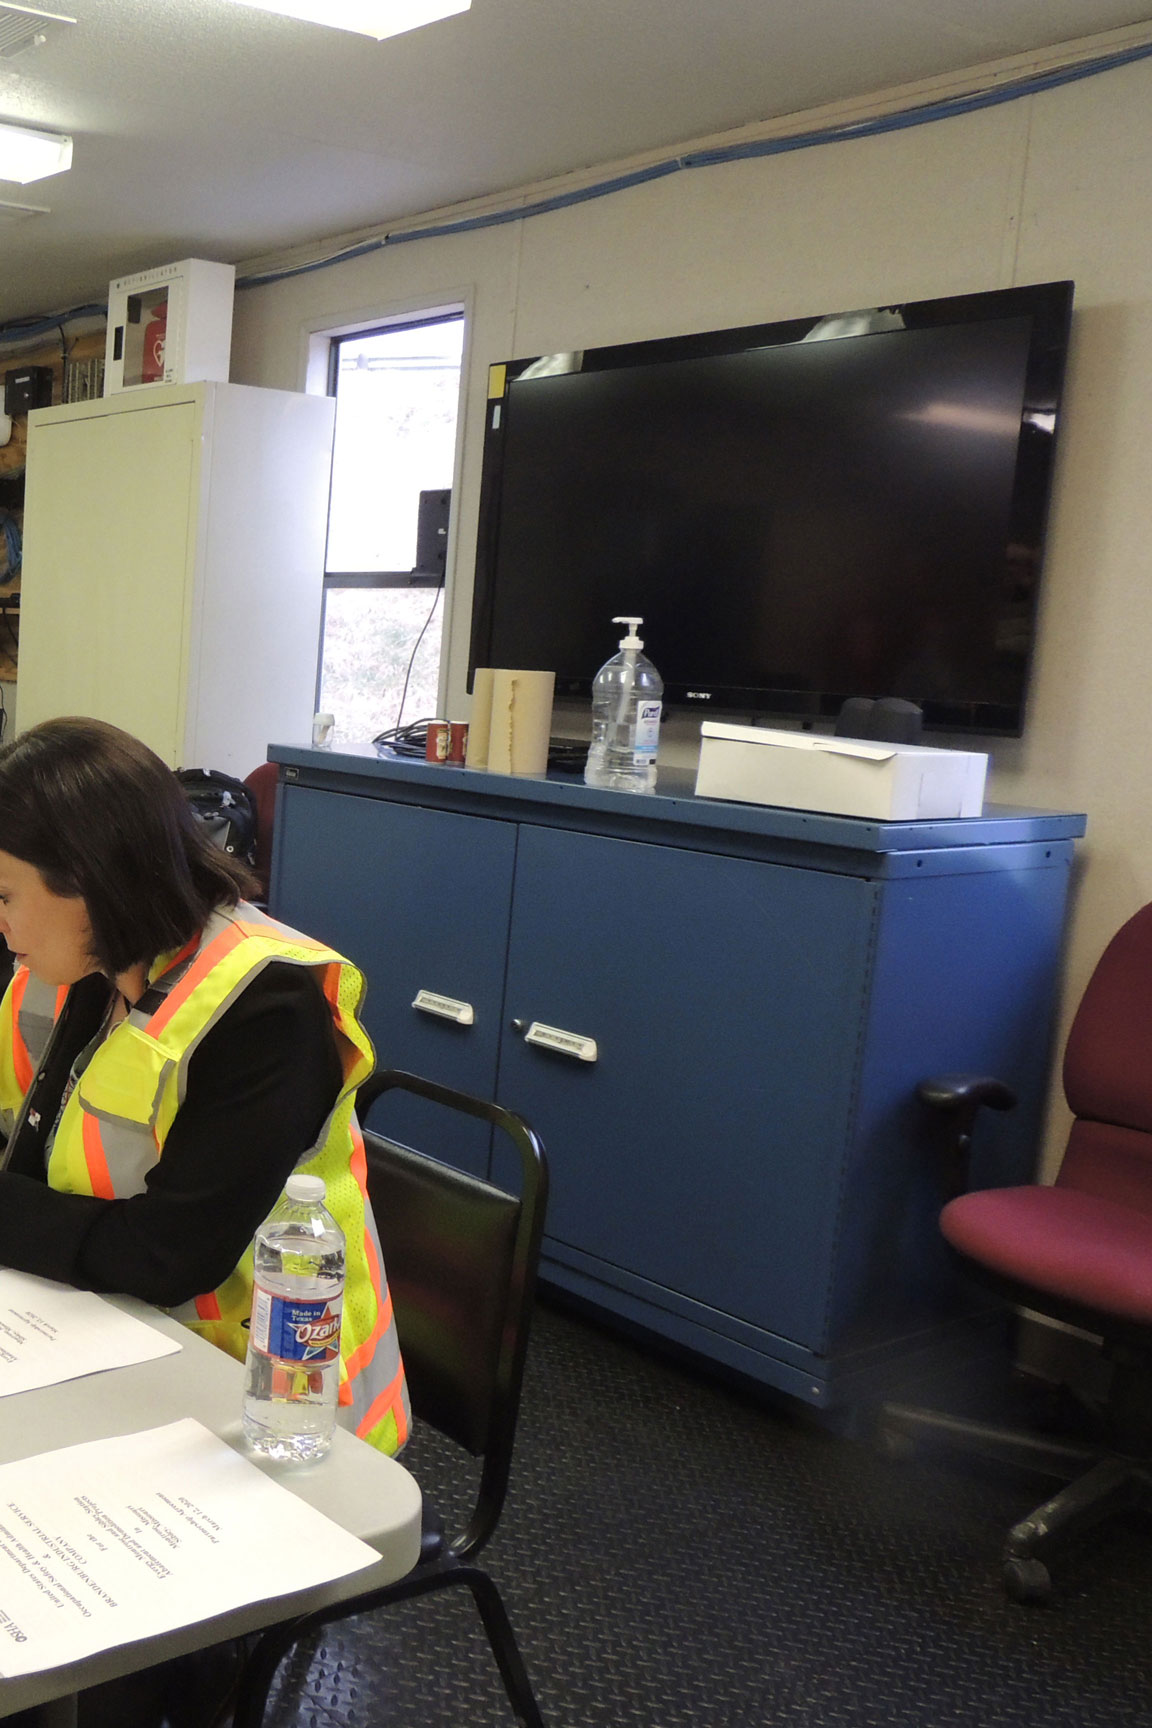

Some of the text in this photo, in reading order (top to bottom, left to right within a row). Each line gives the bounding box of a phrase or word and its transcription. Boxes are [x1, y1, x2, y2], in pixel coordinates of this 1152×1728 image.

[105, 1527, 119, 1537] and
[83, 1532, 108, 1551] For the
[127, 1539, 142, 1549] and
[2, 1622, 29, 1643] OSHA
